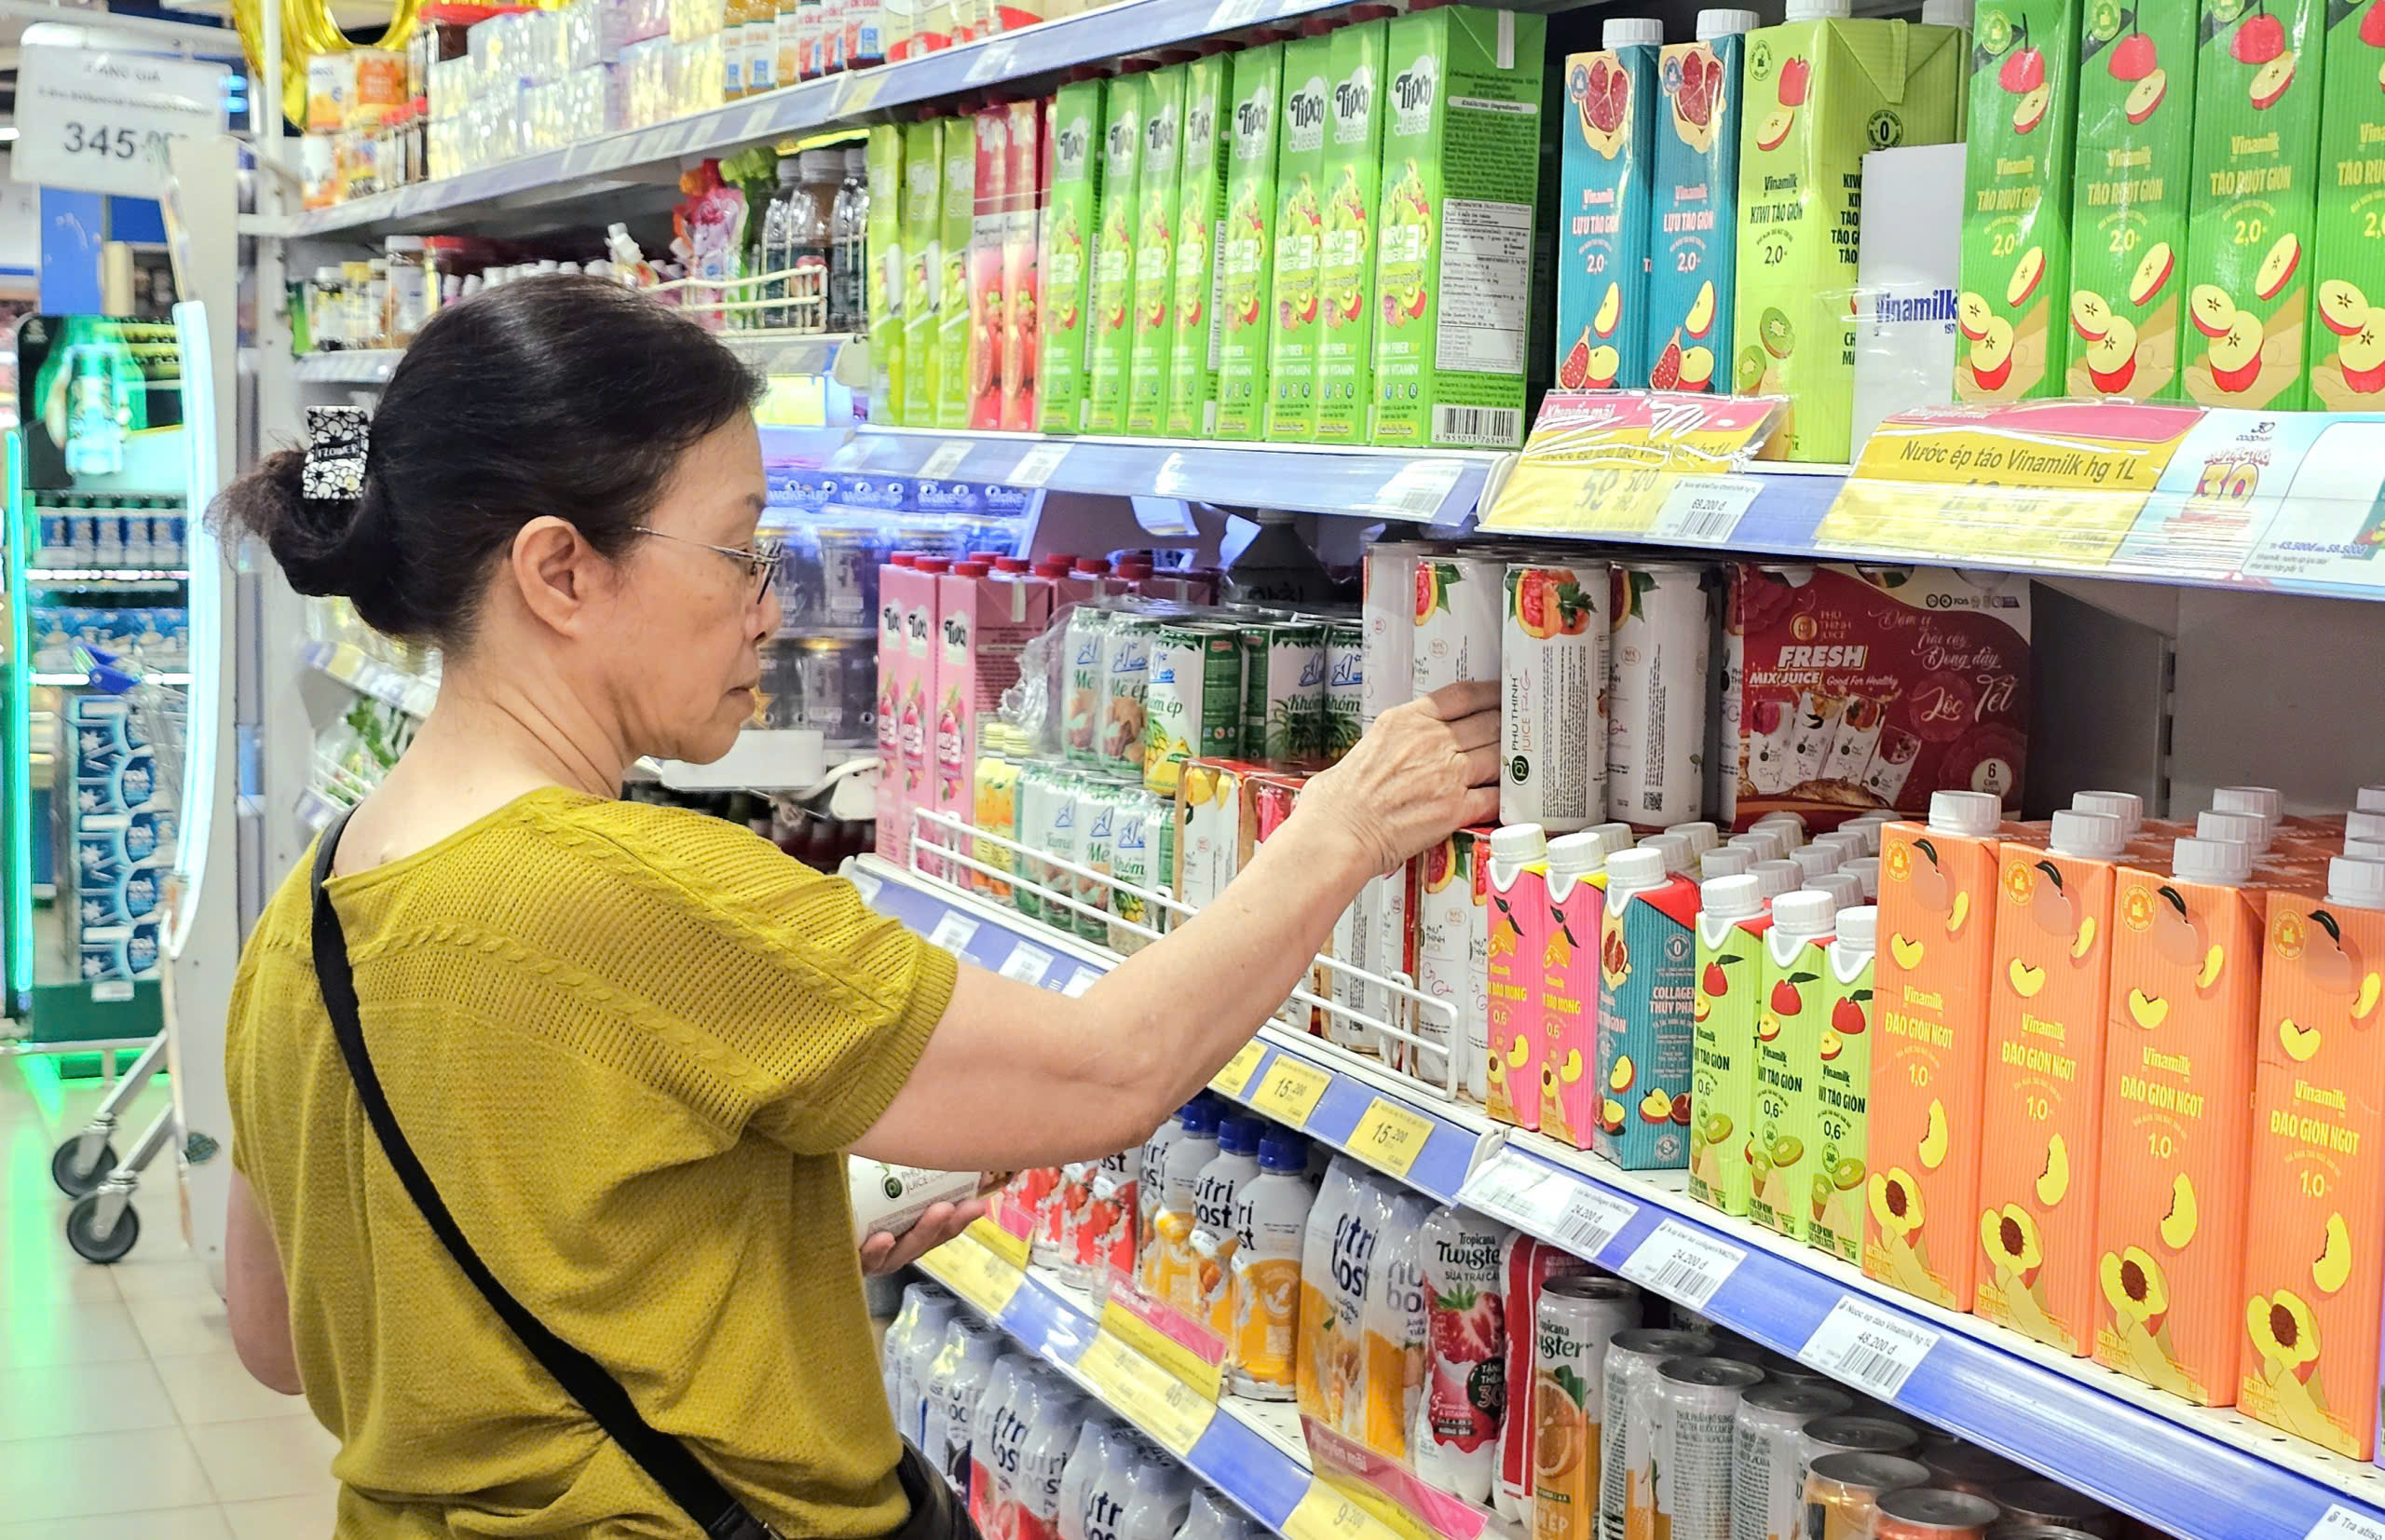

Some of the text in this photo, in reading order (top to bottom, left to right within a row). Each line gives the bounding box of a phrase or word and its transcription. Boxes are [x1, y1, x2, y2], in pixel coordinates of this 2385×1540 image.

[1336, 83, 1370, 119] Tipco
[1396, 74, 1432, 110] Tipco
[1290, 92, 1324, 128] Tipco
[2360, 122, 2385, 143] Vina
[1764, 173, 1798, 193] Vinamilk
[1843, 173, 1861, 188] KIW
[2365, 158, 2385, 184] RU
[1751, 204, 1771, 225] KIWI
[1944, 324, 1956, 334] 197
[1901, 440, 2138, 484] Nước ép táo Vinamilk hg 1L
[1778, 645, 1867, 671] FRESH
[1750, 672, 1820, 686] MIX JUICE
[1826, 675, 1849, 687] Good
[1865, 675, 1899, 690] Healthy
[1166, 696, 1183, 717] ép
[1511, 677, 1520, 721] THINH
[1987, 762, 1997, 779] 6
[1903, 984, 1943, 1011] Vinamilk
[1885, 1011, 1954, 1051] ĐÀO GIÒN NGỌT
[2022, 1013, 2065, 1043] Vinamilk
[2002, 1040, 2077, 1082] ĐÀO GIÒN NGỌT
[2143, 1045, 2191, 1077] Vinamilk
[2120, 1074, 2204, 1119] ĐÀO GIÒN NGỌT
[2295, 1079, 2347, 1111] Vinamilk
[2270, 1109, 2361, 1156] ĐÀO GIÒN NGỌT
[1458, 1232, 1497, 1247] Tropicana
[1436, 1240, 1502, 1271] Twiste
[2341, 1517, 2357, 1530] Tra
